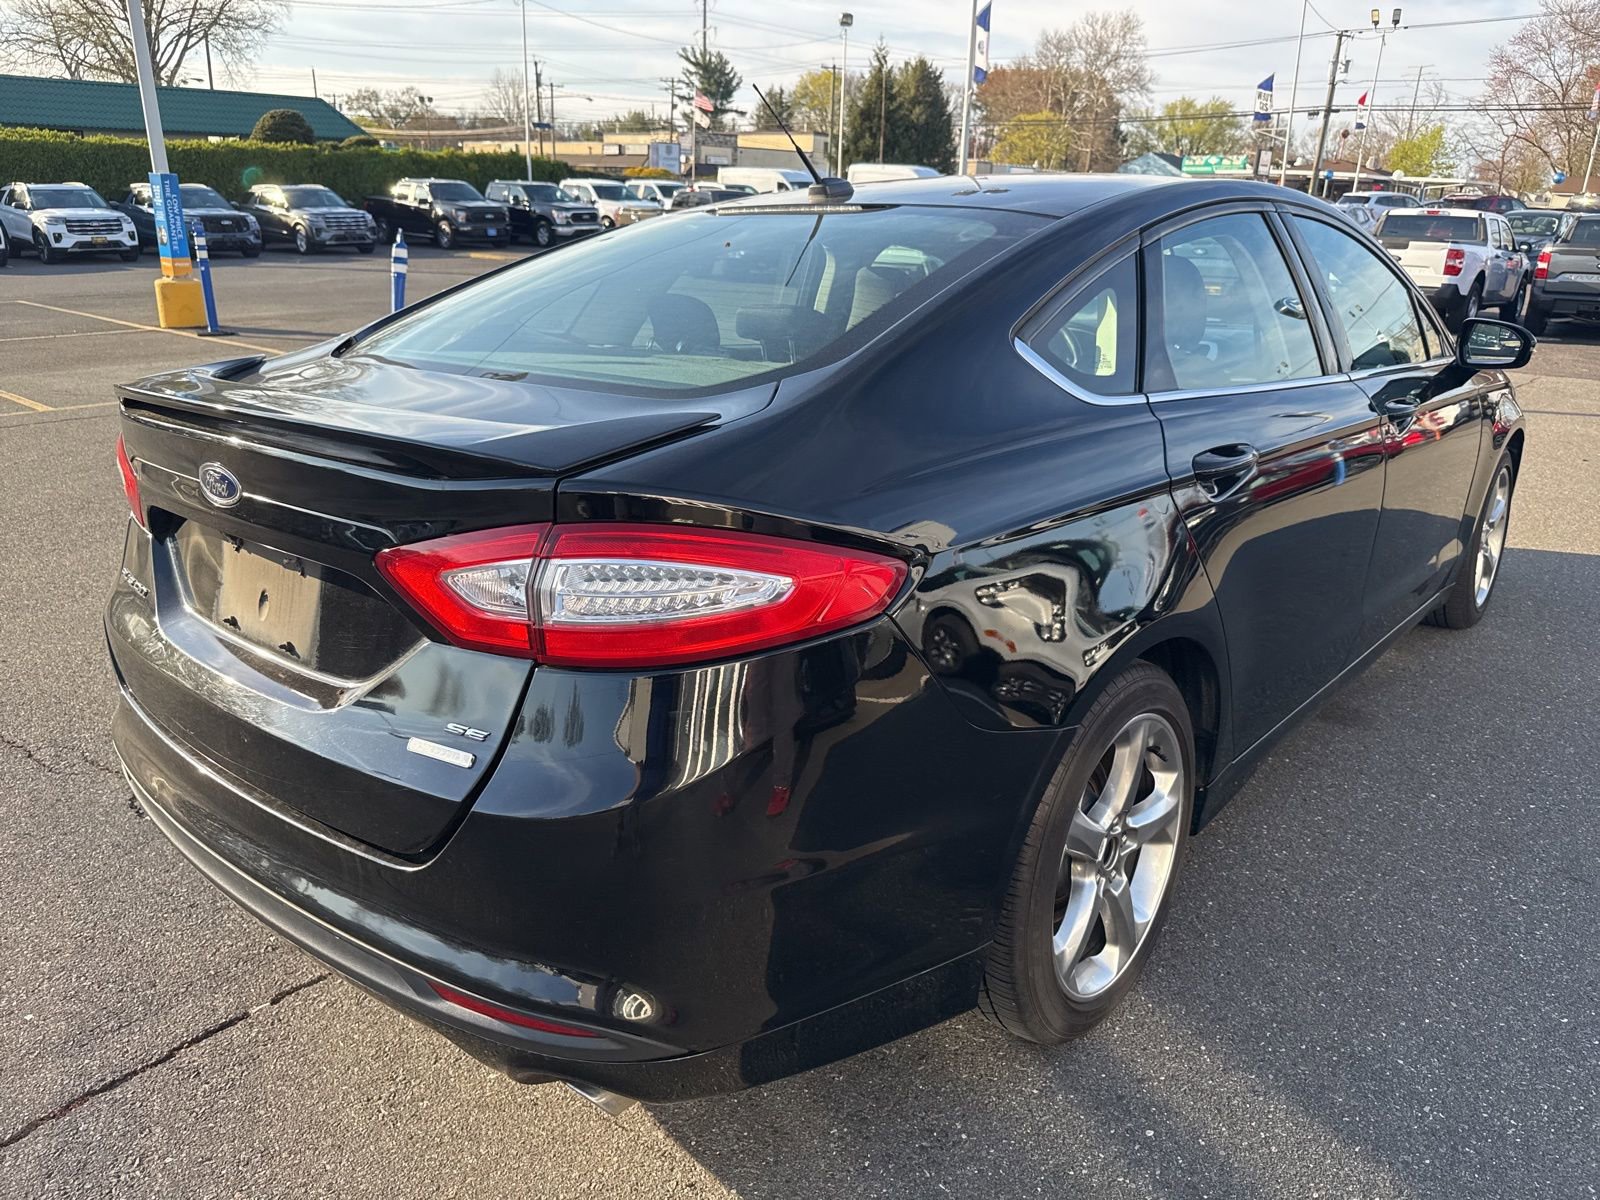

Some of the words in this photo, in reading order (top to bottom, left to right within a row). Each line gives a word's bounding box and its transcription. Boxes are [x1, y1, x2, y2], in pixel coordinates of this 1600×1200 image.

[171, 194, 180, 216] LOW
[176, 216, 184, 240] PRICE
[205, 470, 229, 497] Ford
[444, 722, 491, 742] SE
